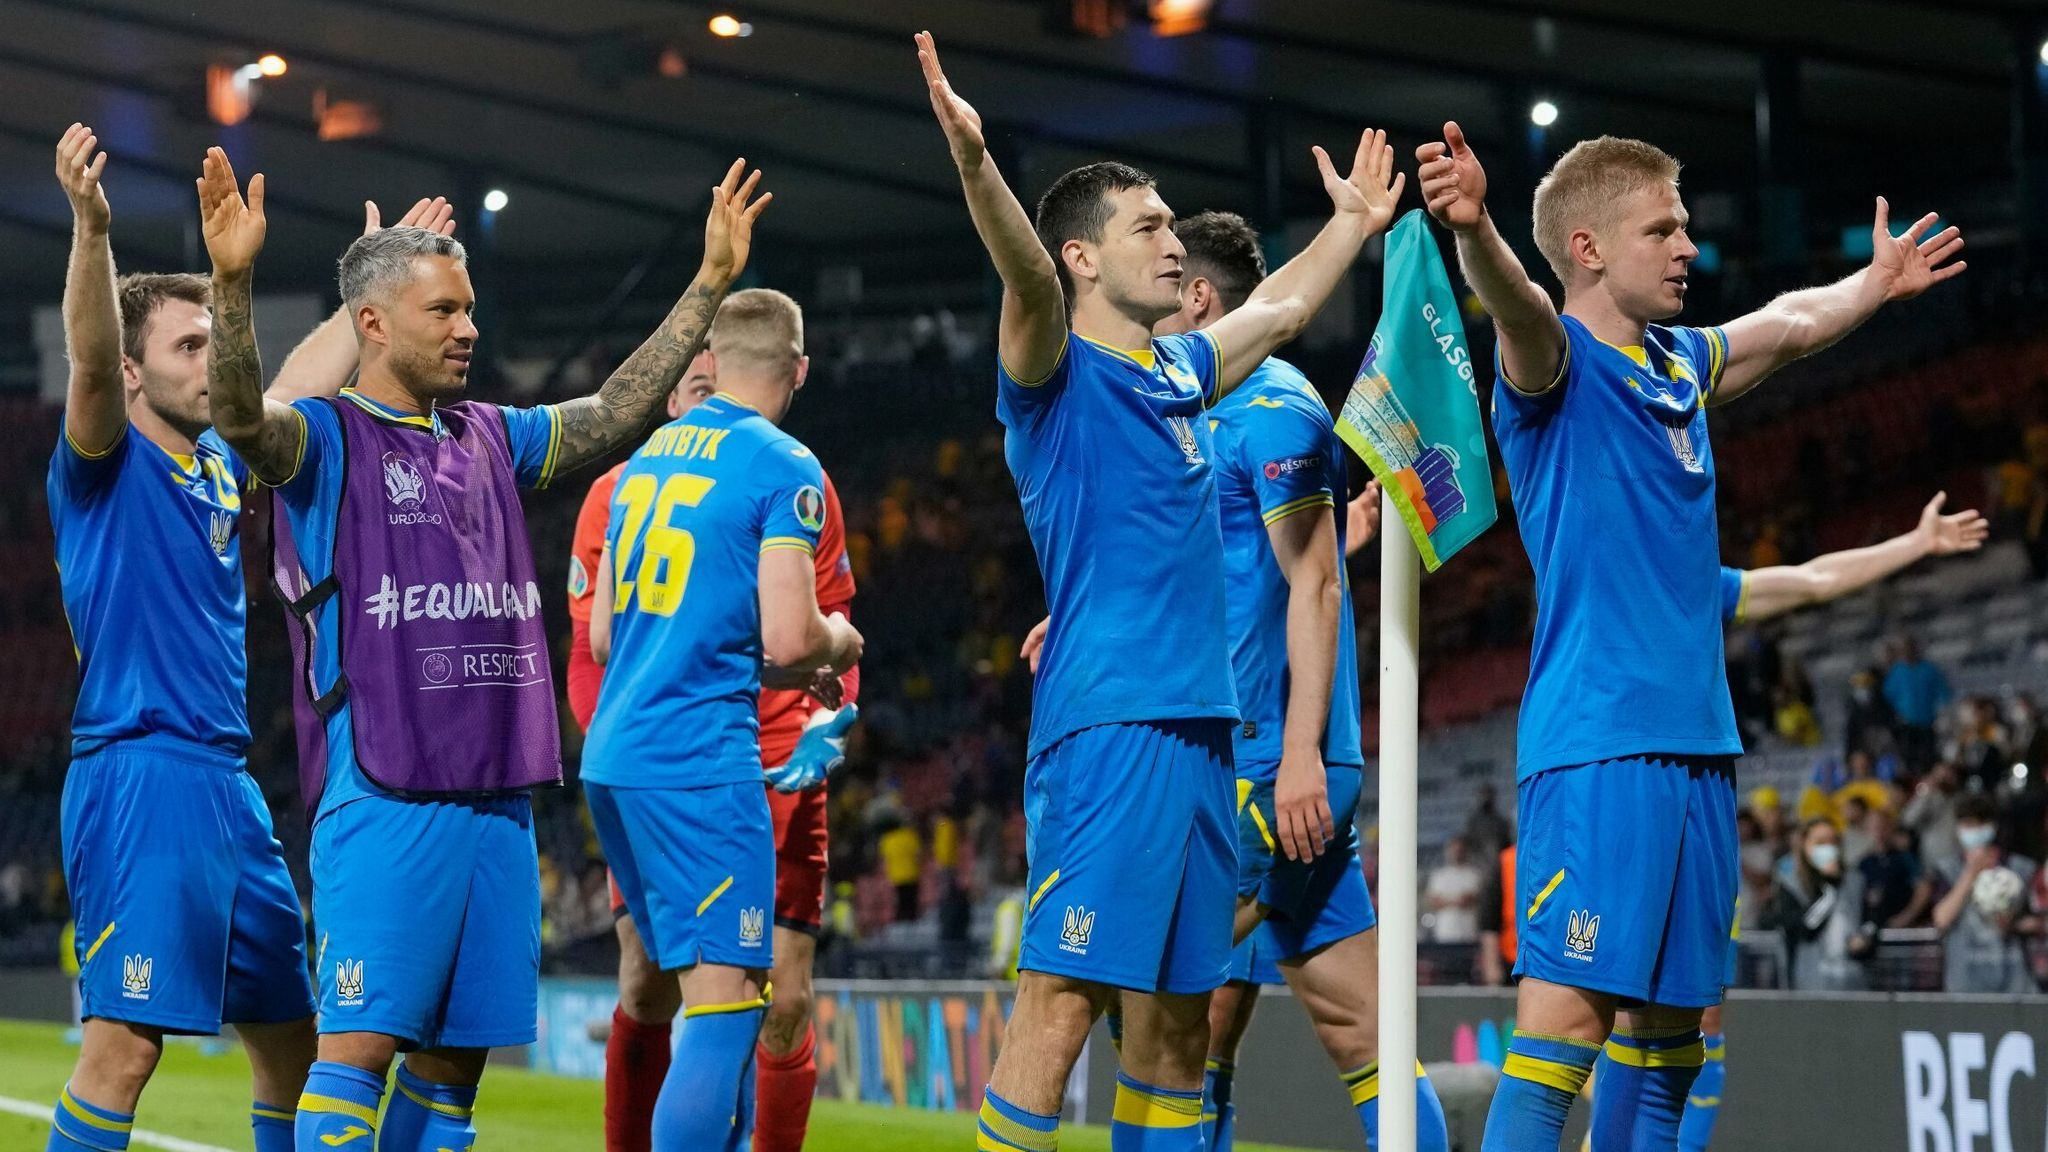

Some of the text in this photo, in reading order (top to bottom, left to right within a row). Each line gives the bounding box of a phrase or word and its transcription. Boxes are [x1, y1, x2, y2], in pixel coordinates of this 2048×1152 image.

[1422, 303, 1479, 408] GLASGO
[1280, 458, 1320, 472] RESPECT
[613, 473, 717, 618] 26
[463, 652, 538, 678] RESPECT
[1058, 943, 1087, 955] UKRAINE
[1563, 950, 1594, 962] UKRAINE
[1901, 1030, 2048, 1152] BEC
